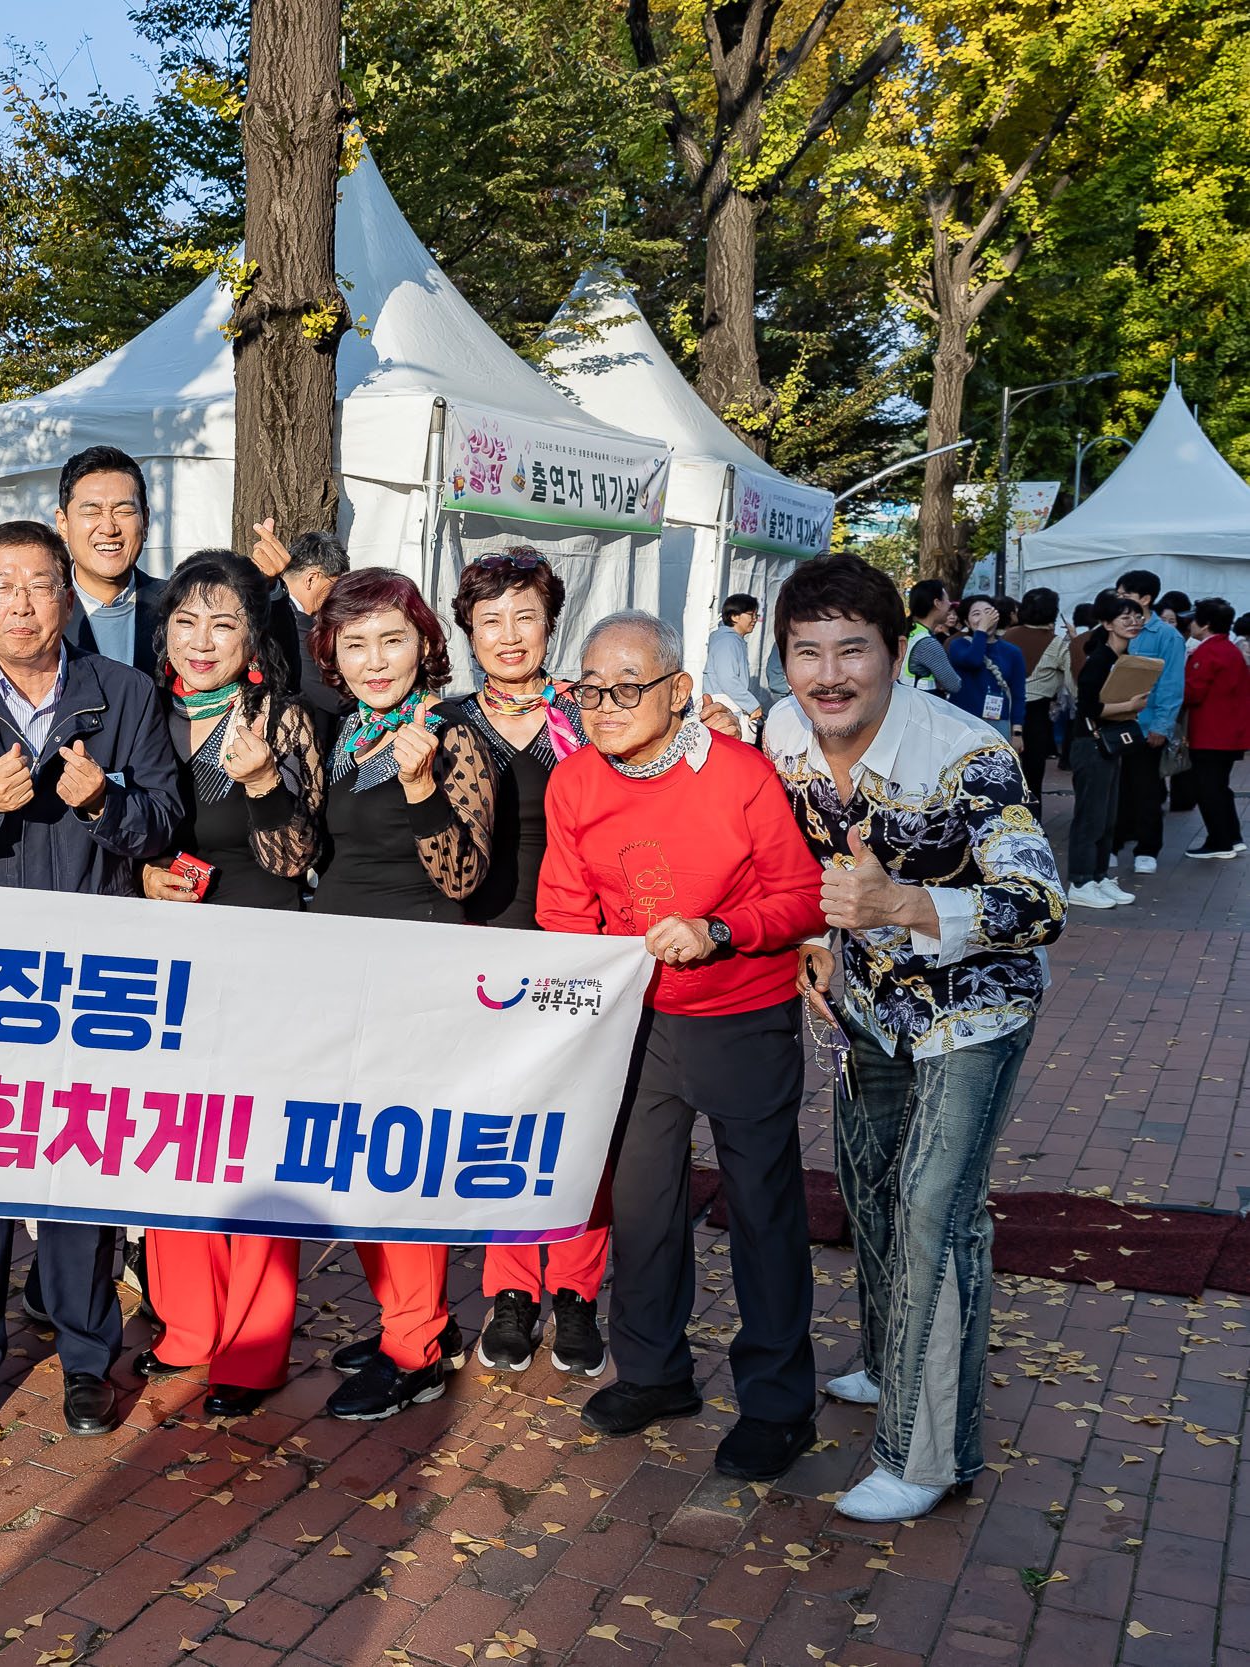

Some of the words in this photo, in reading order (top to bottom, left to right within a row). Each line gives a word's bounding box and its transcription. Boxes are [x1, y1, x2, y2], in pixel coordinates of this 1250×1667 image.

[468, 429, 508, 462] 신나는
[470, 456, 504, 495] 광진
[530, 460, 584, 508] 출연자
[592, 473, 639, 515] 대기실
[768, 508, 793, 543] 출연자
[531, 989, 602, 1016] 행복광진
[534, 978, 568, 991] 소통하며
[568, 978, 603, 993] 발전하는
[274, 1100, 566, 1199] 파이팅!
